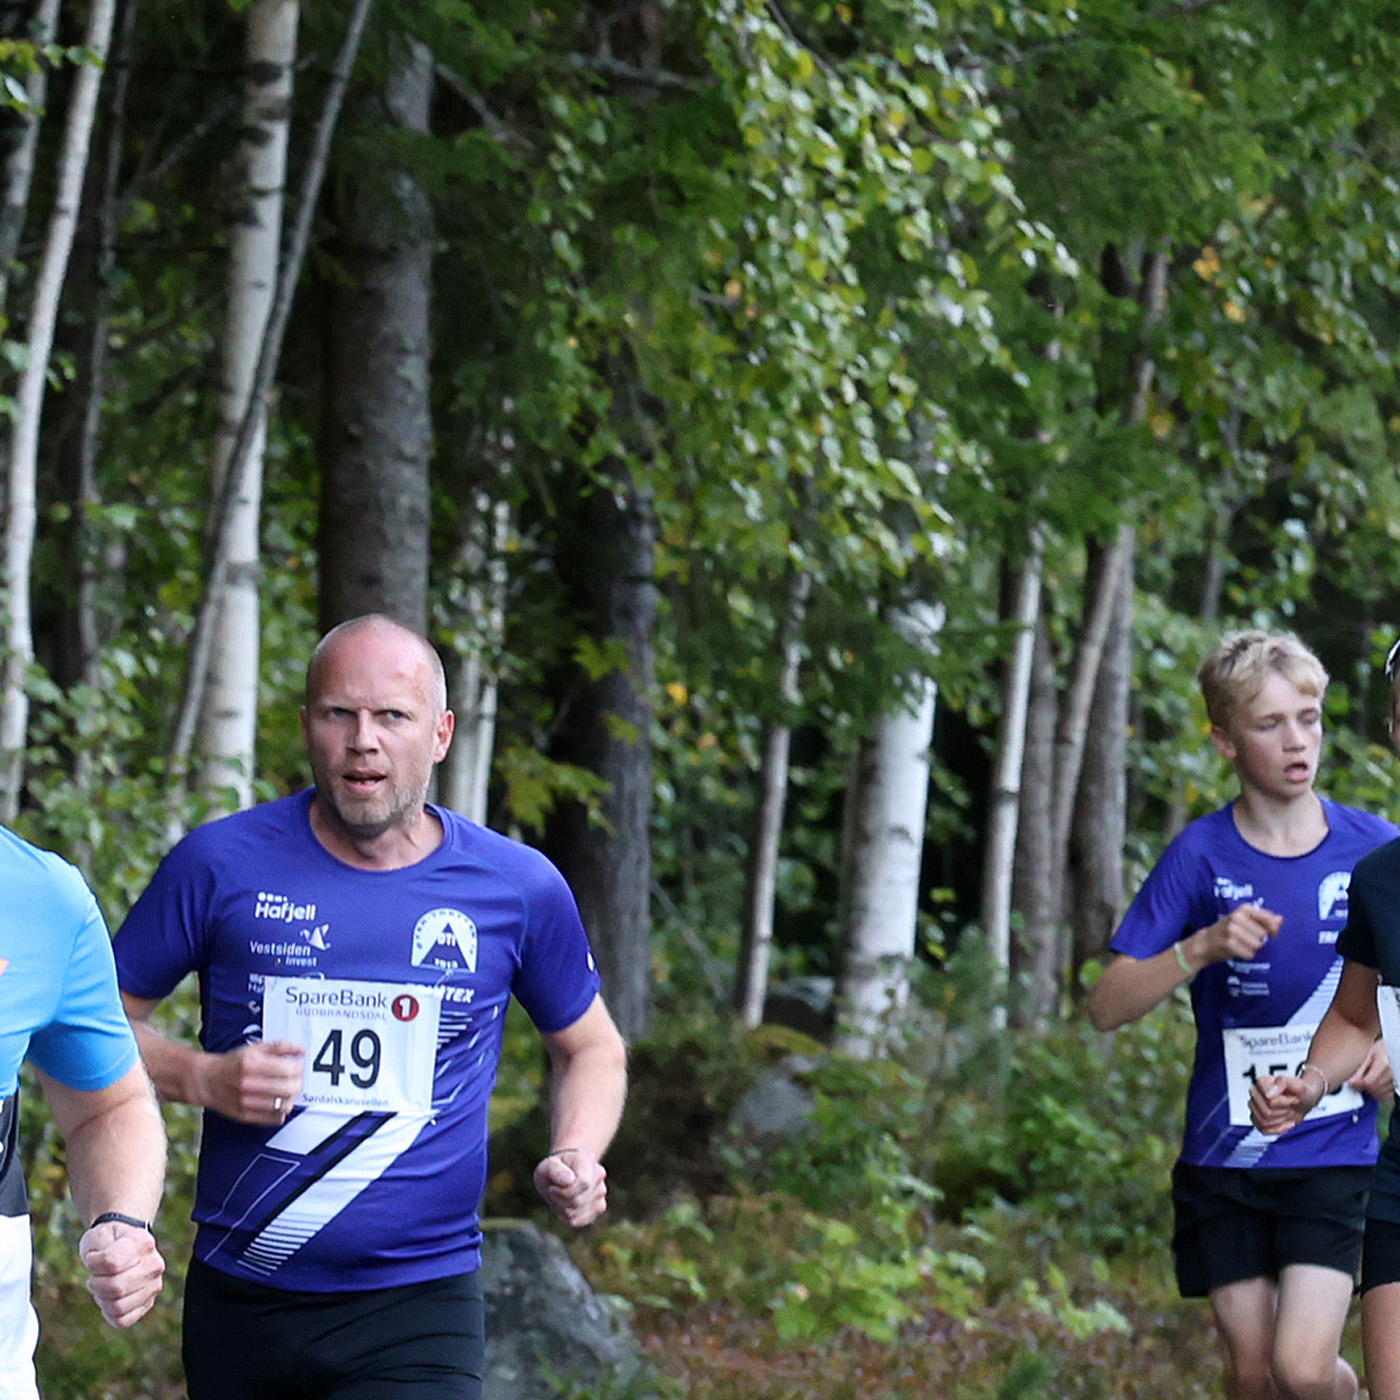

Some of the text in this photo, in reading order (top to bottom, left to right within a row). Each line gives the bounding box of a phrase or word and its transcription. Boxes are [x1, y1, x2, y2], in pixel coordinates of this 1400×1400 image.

[255, 902, 317, 923] Hafjell
[285, 986, 388, 1010] SpareBank
[311, 1028, 382, 1090] 49
